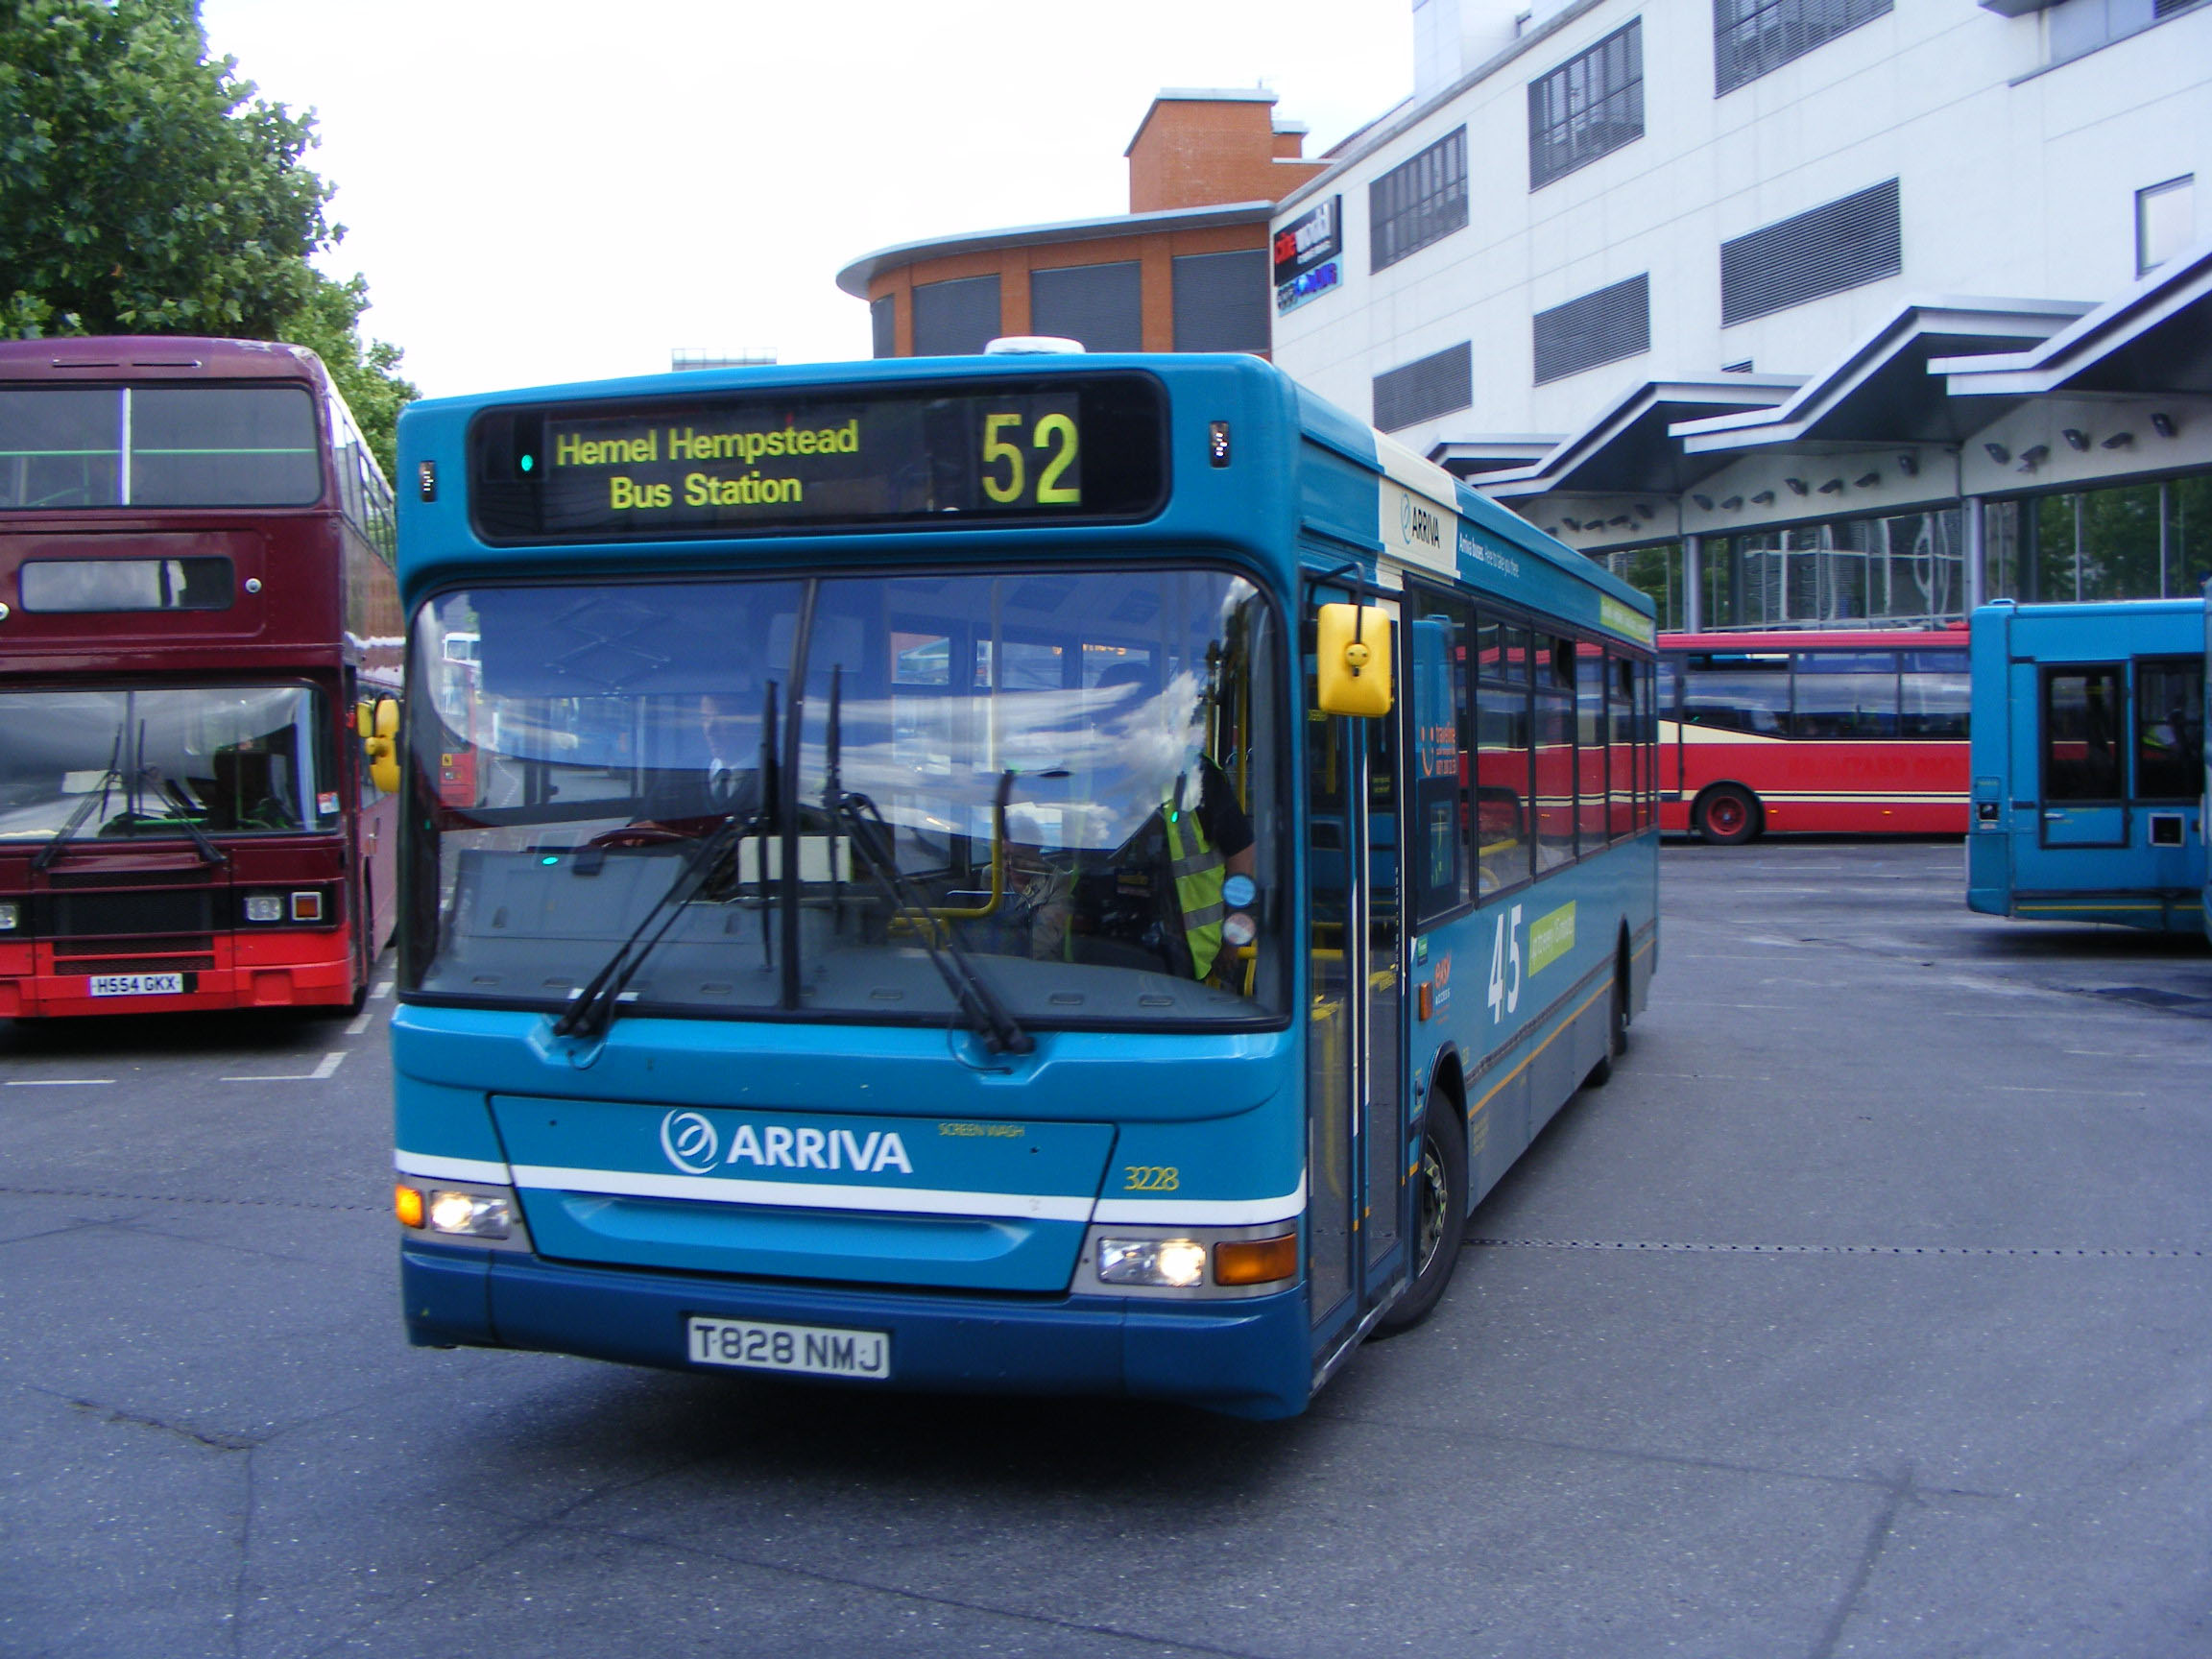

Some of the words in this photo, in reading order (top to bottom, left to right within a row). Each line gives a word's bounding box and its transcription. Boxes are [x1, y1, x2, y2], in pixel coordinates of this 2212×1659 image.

[557, 429, 658, 466] Hemel
[668, 419, 859, 465] Hempstead
[982, 413, 1081, 504] 52
[610, 475, 672, 510] Bus
[685, 470, 803, 507] Station
[1412, 506, 1440, 549] ARRIVA
[97, 977, 139, 993] H554
[144, 975, 177, 992] GKX
[1487, 903, 1522, 1024] 45
[725, 1124, 914, 1174] ARRIVA
[1122, 1165, 1180, 1191] 3228
[694, 1324, 795, 1364] T828
[805, 1333, 882, 1373] NMJ
